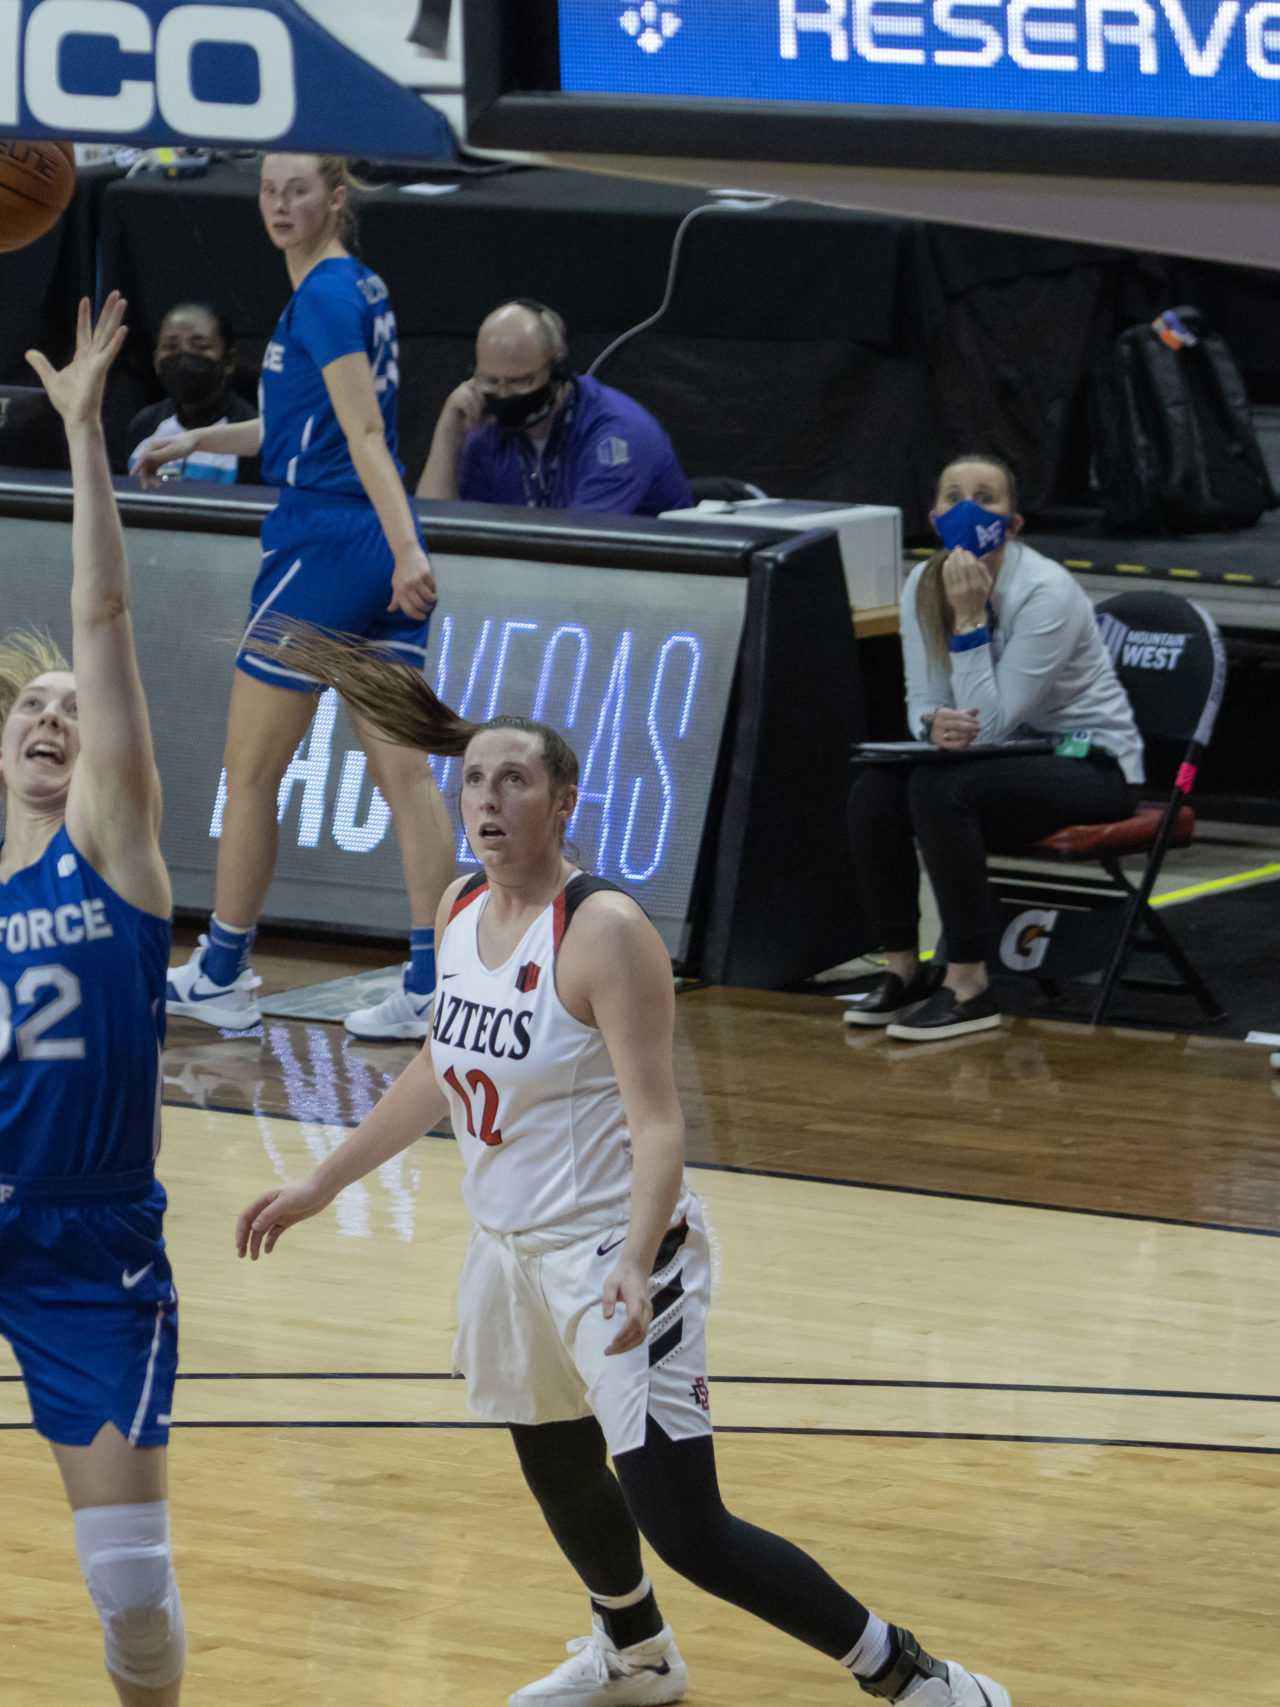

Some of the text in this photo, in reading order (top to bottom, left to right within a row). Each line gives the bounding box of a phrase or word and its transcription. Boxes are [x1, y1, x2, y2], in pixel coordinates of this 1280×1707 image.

[1122, 643, 1183, 671] WEST
[999, 909, 1059, 971] G
[432, 991, 534, 1060] AZTECS
[442, 1064, 503, 1146] 12
